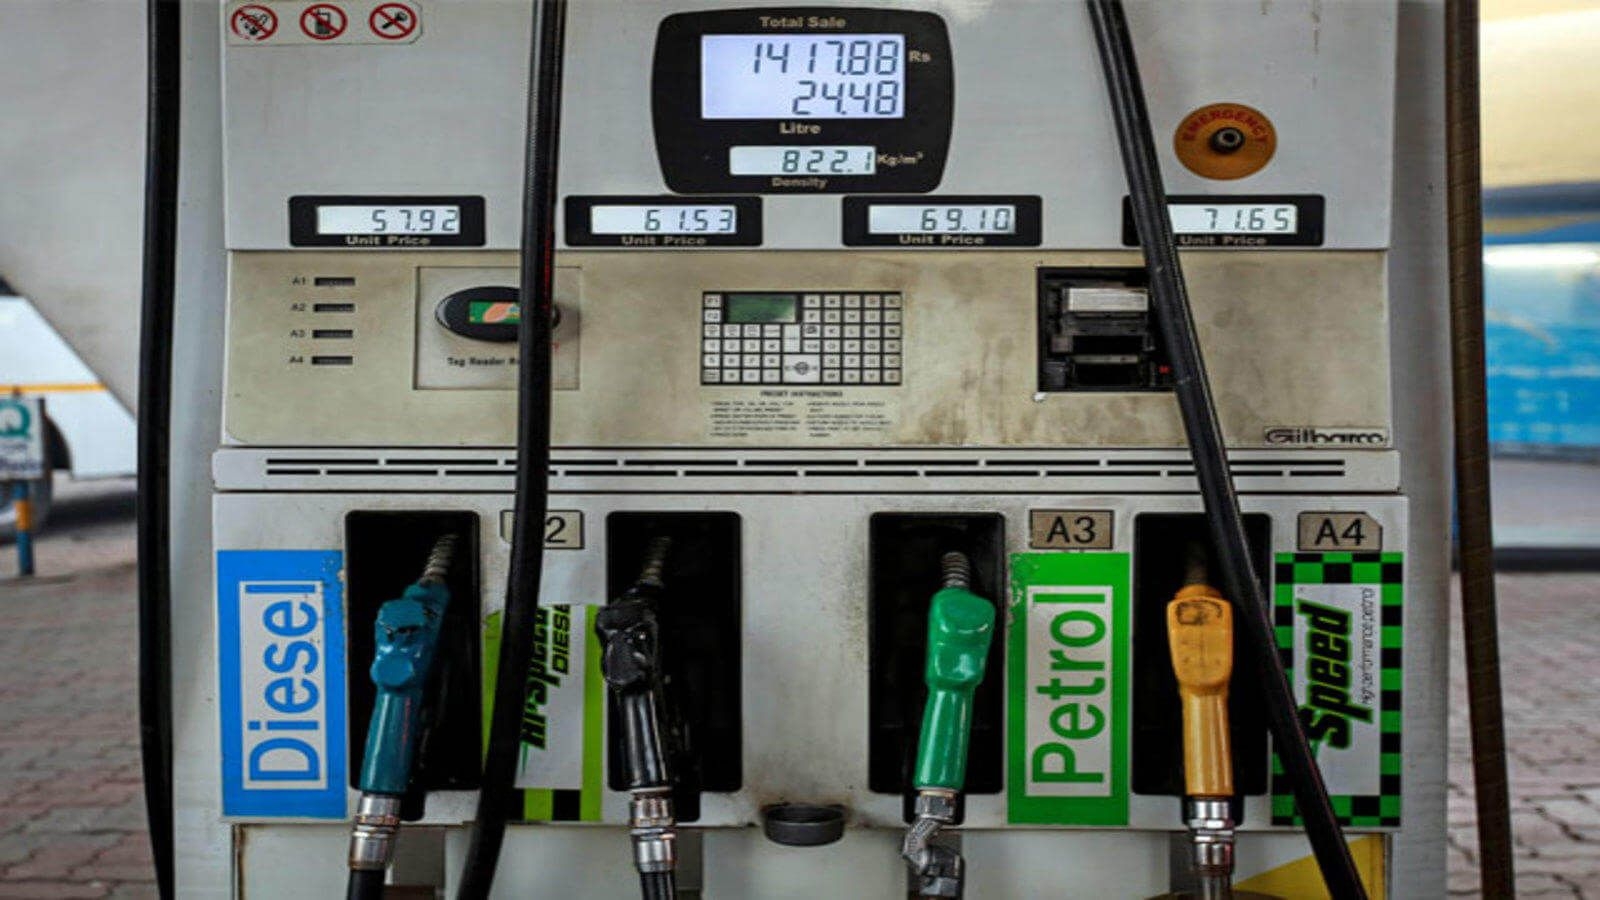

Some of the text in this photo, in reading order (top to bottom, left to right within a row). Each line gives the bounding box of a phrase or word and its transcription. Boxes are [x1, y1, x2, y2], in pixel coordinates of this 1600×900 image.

[759, 16, 847, 29] Total Sale
[753, 40, 900, 76] 1417.88
[908, 50, 932, 63] Rs
[791, 80, 900, 116] 24.48
[779, 122, 822, 135] Litre
[1182, 109, 1269, 142] EMERGENCY
[782, 150, 874, 173] 822.1
[771, 177, 829, 190] Density
[371, 209, 460, 233] 57.92
[643, 209, 735, 233] 61.53
[920, 208, 1012, 233] 69.10
[1203, 208, 1291, 232] 71.65
[344, 235, 431, 246] Unit Price
[621, 235, 706, 247] Unit Price
[899, 234, 985, 246] Unit Price
[1180, 235, 1268, 247] Unit Price
[447, 357, 466, 369] Tag
[470, 356, 506, 366] Reader
[545, 515, 566, 543] 2
[1046, 515, 1097, 544] A3
[1314, 517, 1366, 546] A4
[552, 603, 572, 676] DIESE
[244, 584, 321, 782] Diesel
[1296, 597, 1374, 750] Speed
[1031, 593, 1107, 783] Petrol
